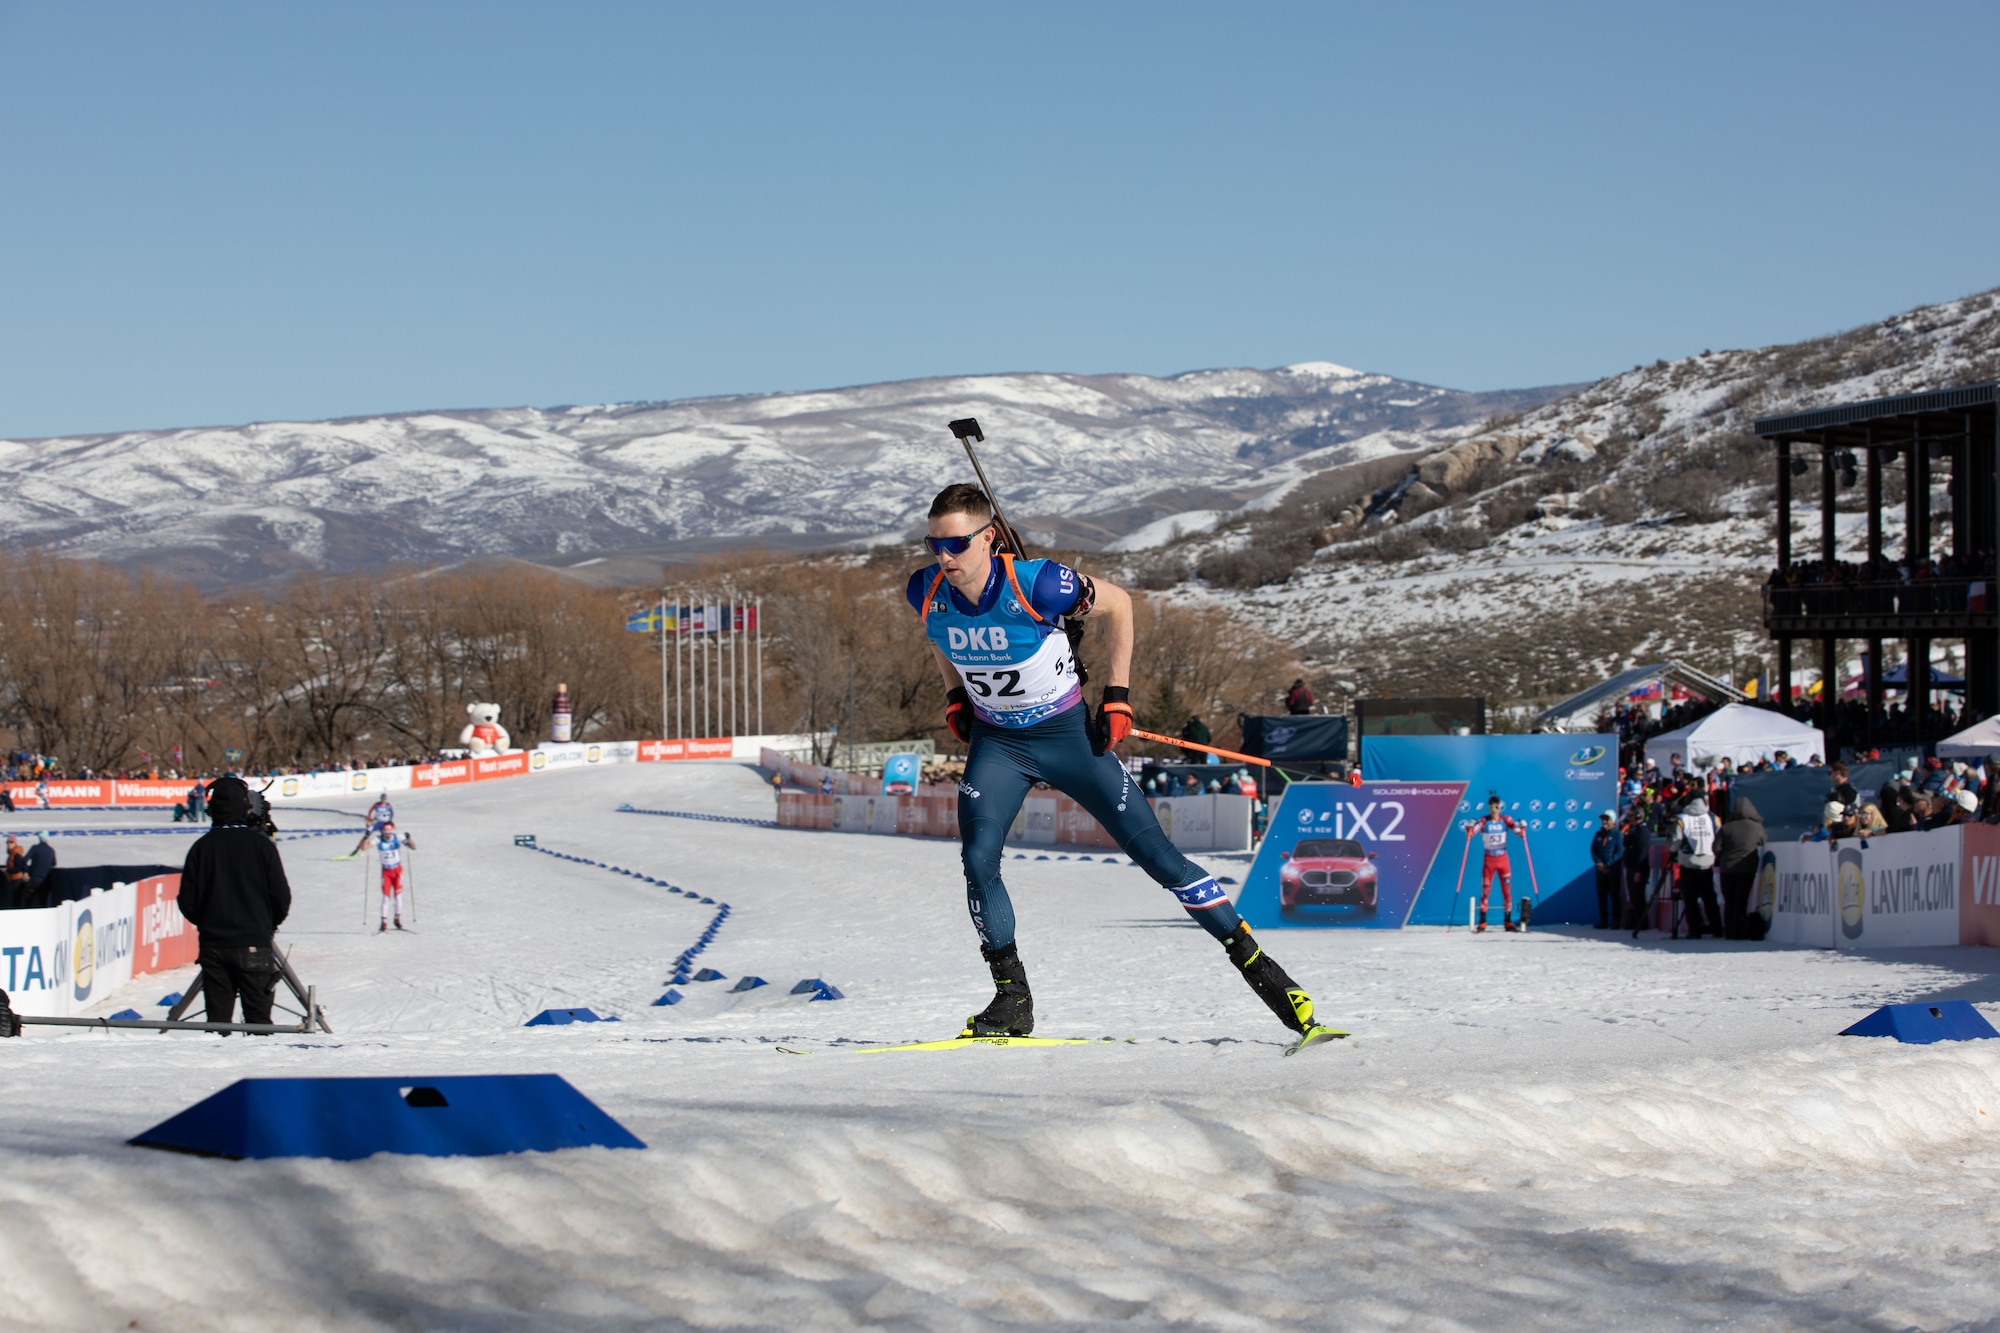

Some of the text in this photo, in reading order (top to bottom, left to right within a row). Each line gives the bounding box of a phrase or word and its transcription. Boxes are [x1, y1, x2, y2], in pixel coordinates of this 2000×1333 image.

[947, 626, 1009, 651] DKB
[951, 652, 1012, 661] Das kann Bank
[965, 669, 1026, 697] 52
[1372, 788, 1460, 796] SOLDIER HOLLOW
[1335, 801, 1406, 842] iX2
[1871, 862, 1954, 915] LAVITA.COM
[969, 899, 991, 944] USA
